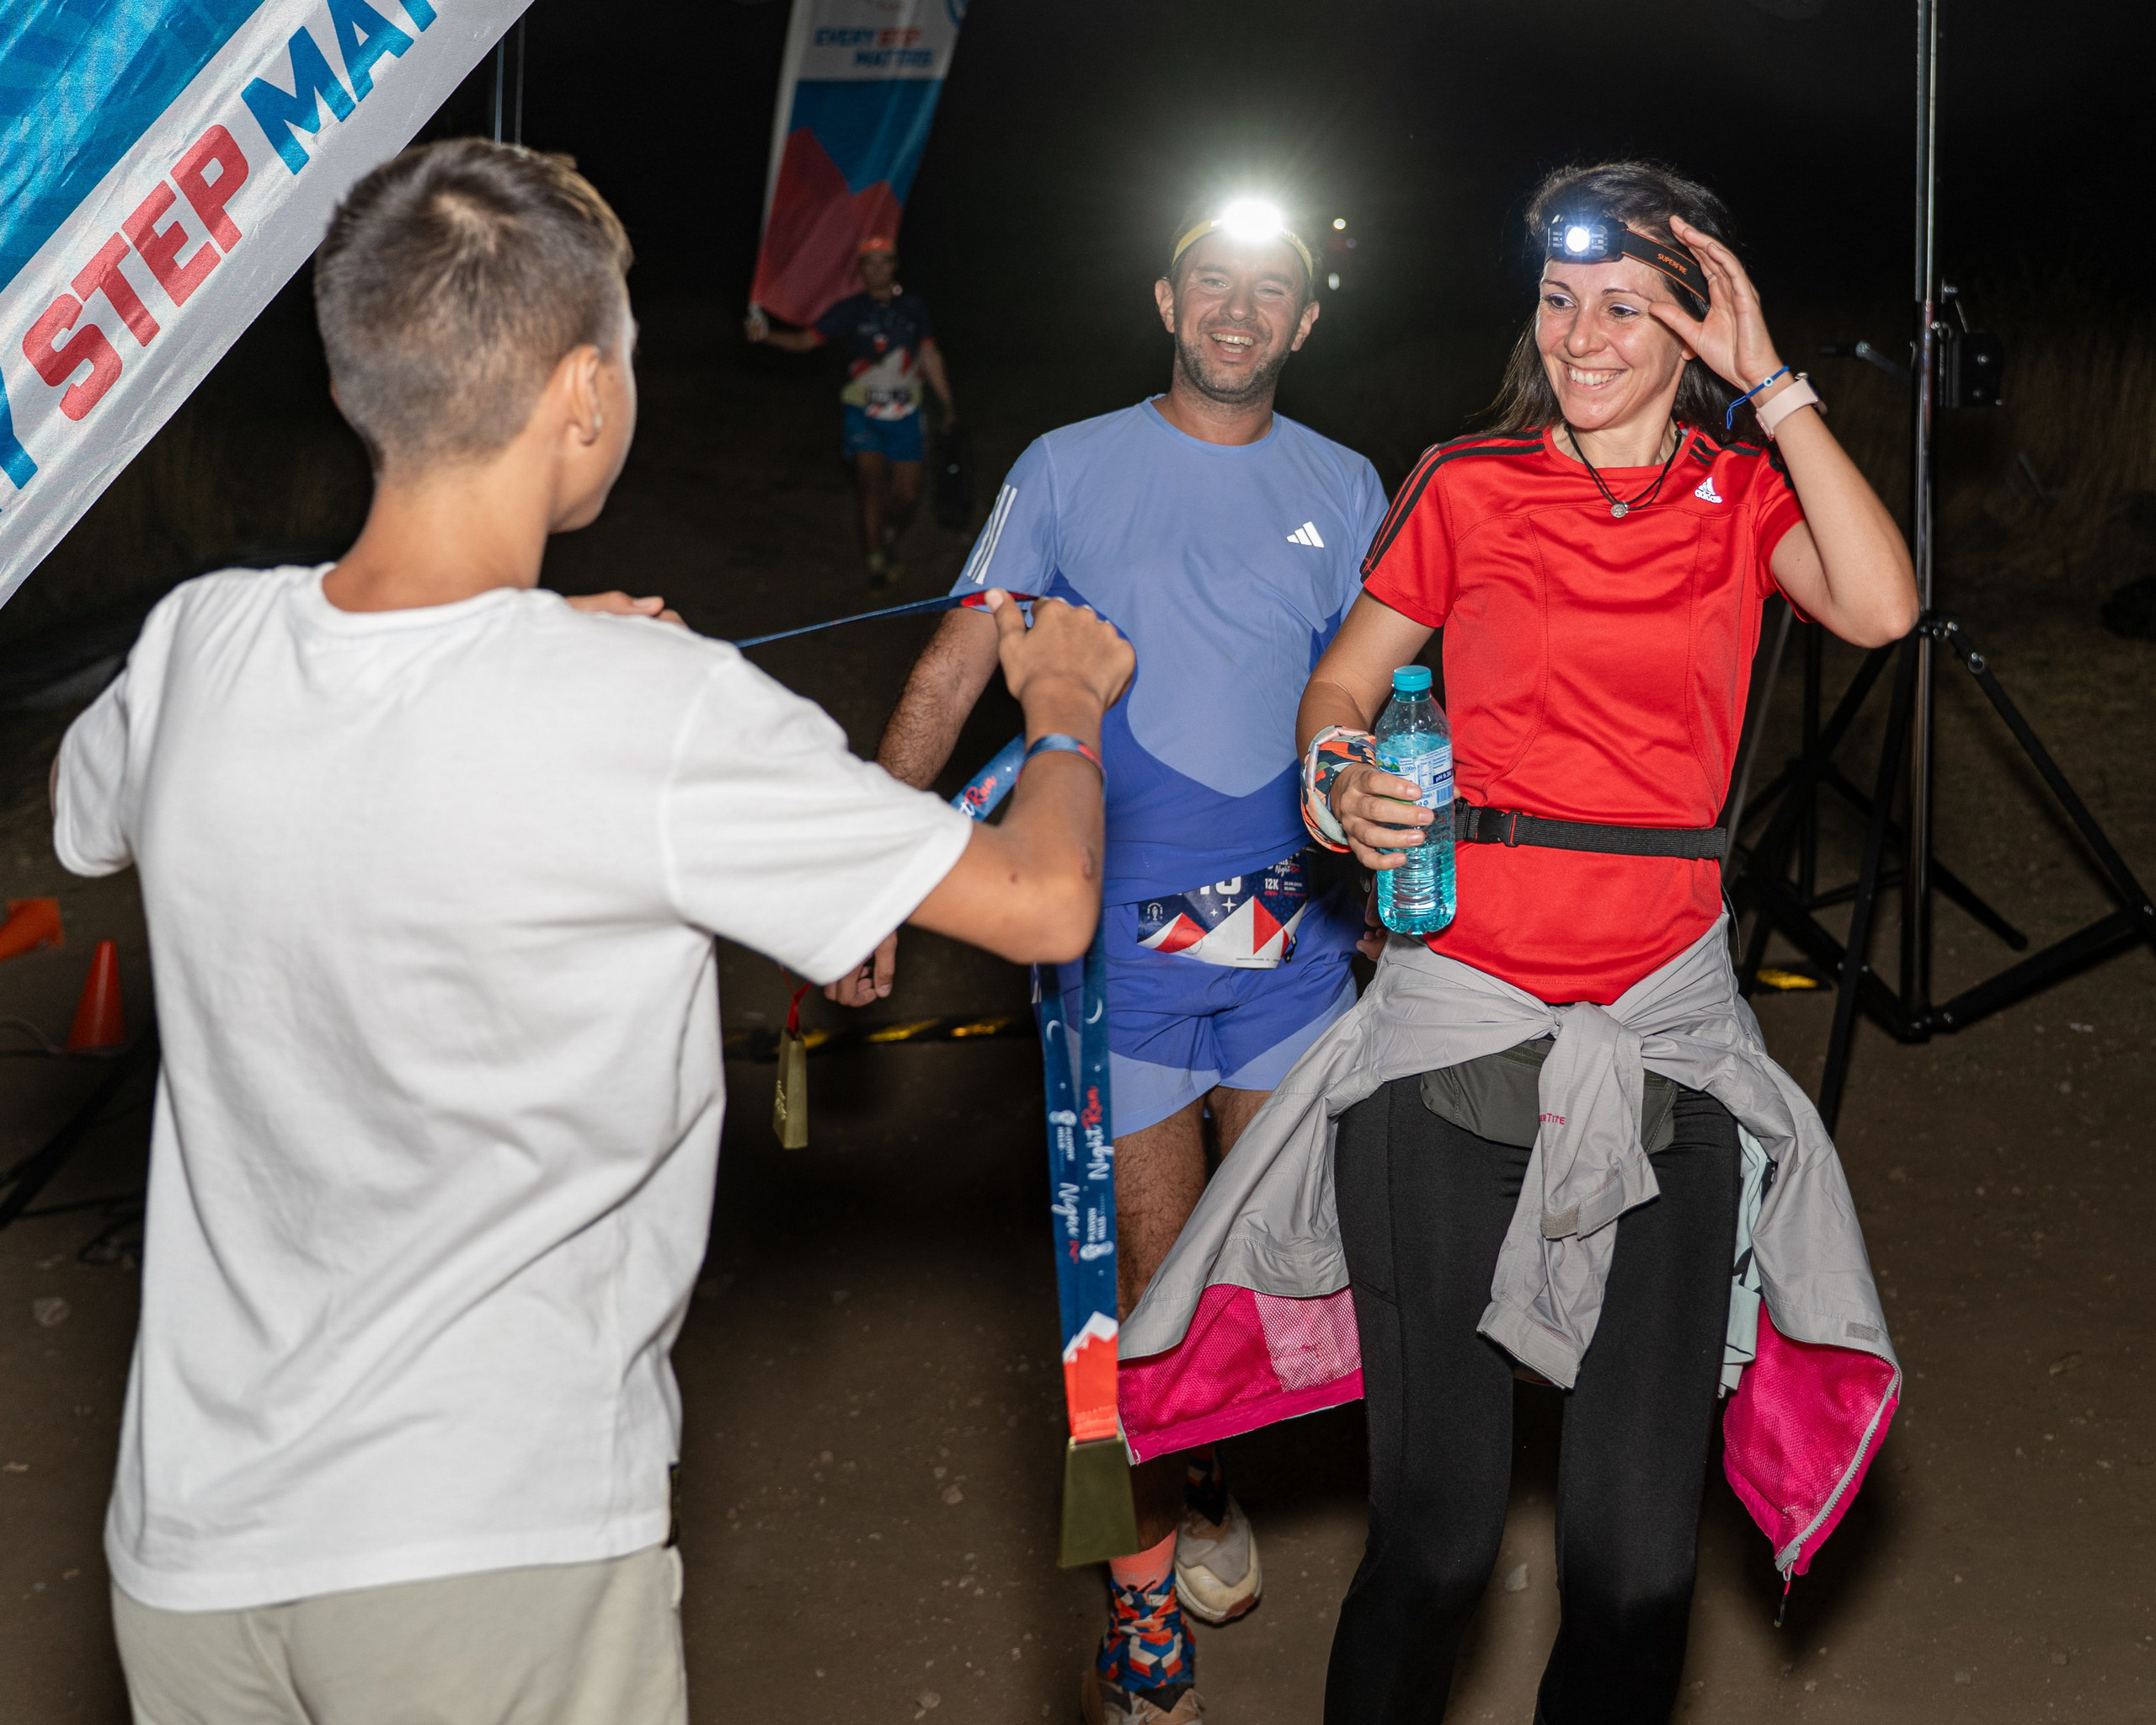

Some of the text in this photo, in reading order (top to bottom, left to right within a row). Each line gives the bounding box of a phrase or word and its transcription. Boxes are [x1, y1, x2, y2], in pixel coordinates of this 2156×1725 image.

[22, 0, 438, 421] STEP MA
[1657, 253, 1688, 275] SUPERFIRE
[1694, 489, 1723, 504] adidas
[964, 776, 997, 808] Run
[1264, 878, 1279, 890] 12K
[1081, 1085, 1115, 1180] Night Run
